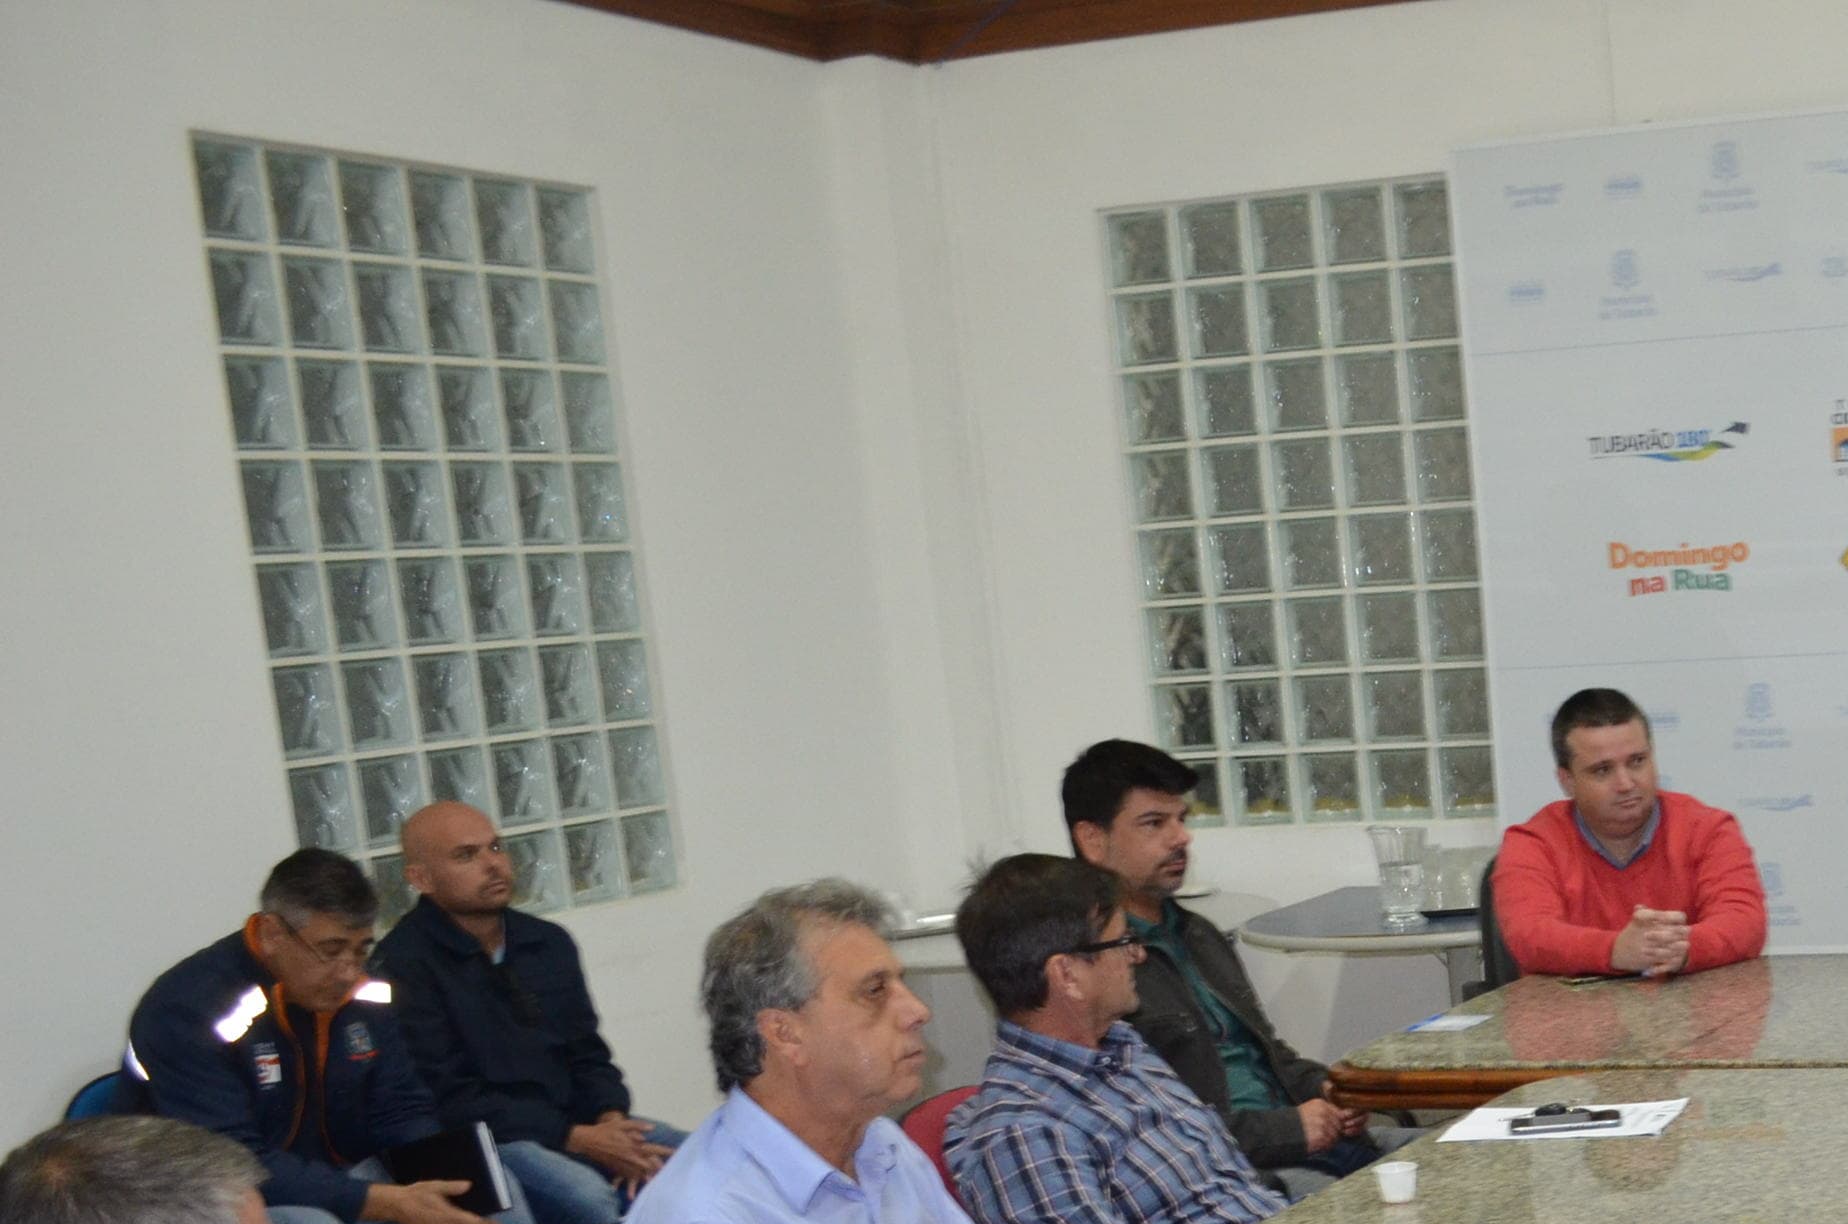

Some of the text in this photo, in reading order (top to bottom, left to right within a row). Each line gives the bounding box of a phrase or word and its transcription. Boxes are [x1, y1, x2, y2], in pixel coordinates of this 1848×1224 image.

[1588, 429, 1675, 454] TUBARÃO
[1607, 541, 1749, 571] Domingo
[1629, 569, 1732, 596] na Rua
